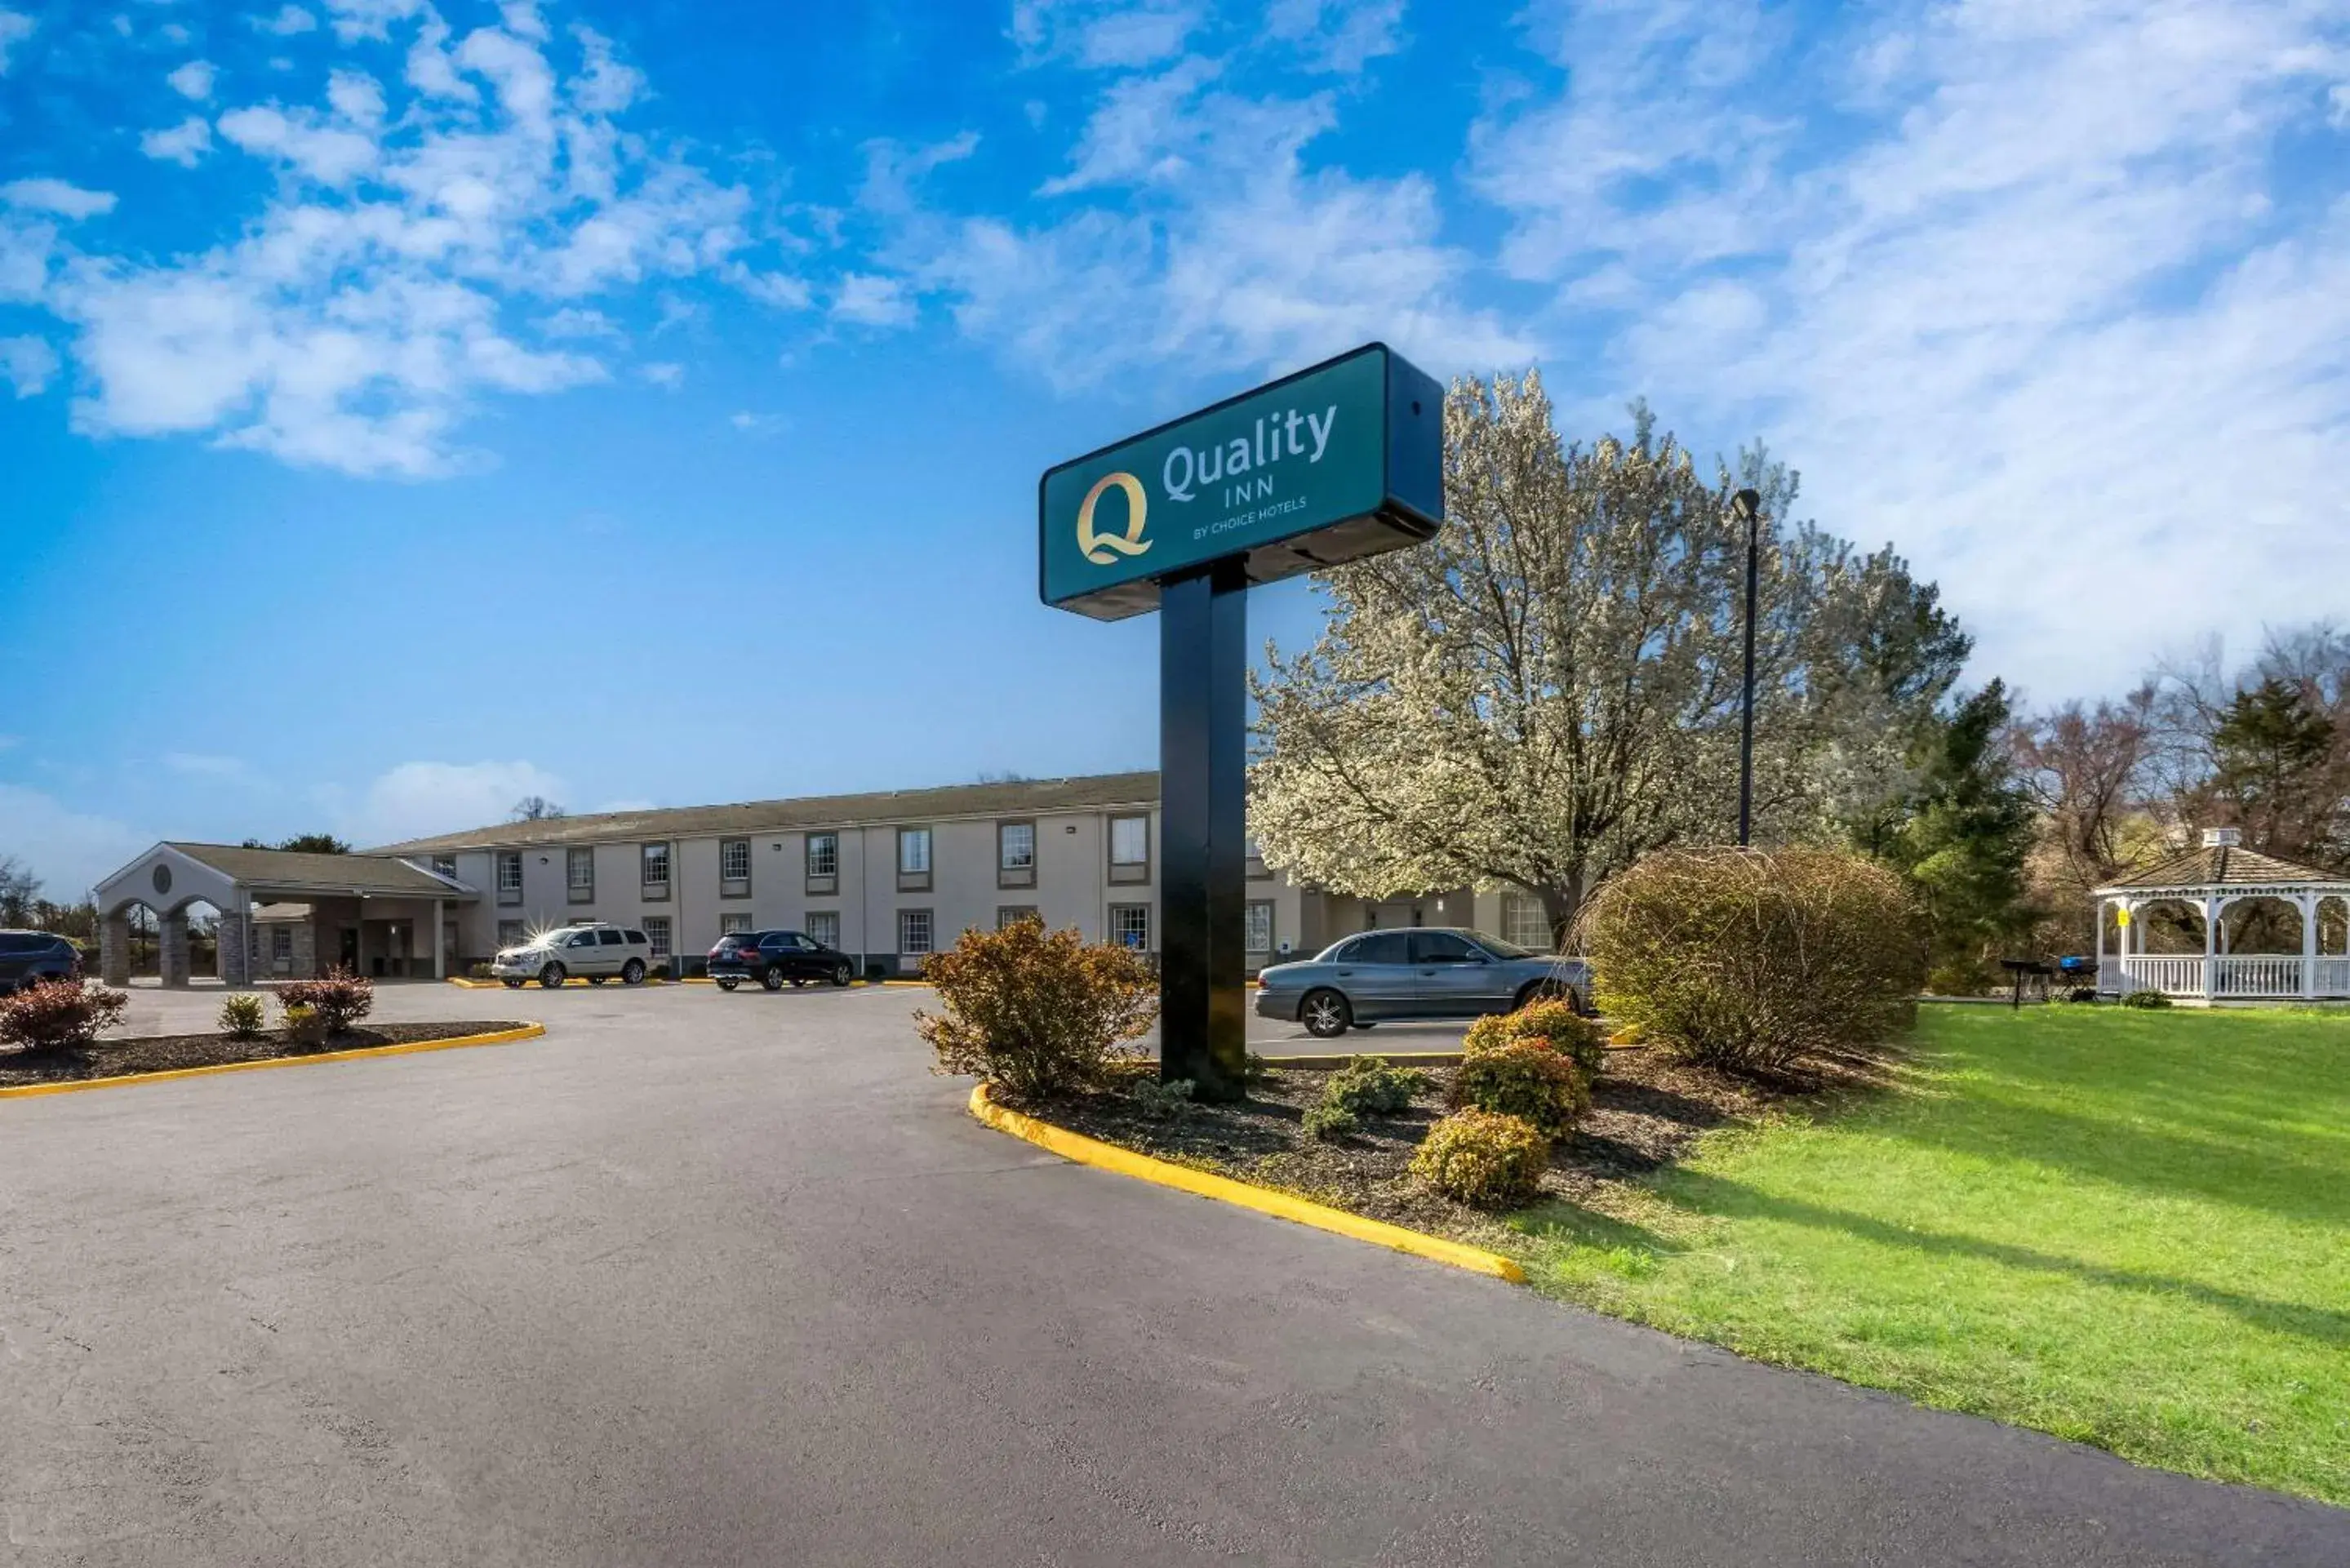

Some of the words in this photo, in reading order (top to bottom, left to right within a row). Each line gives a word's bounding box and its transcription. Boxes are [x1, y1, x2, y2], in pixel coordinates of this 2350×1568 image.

[1163, 405, 1337, 502] Quality
[1077, 472, 1153, 565] Q
[1193, 525, 1211, 540] BY
[1211, 512, 1256, 535] CHOICE
[1259, 496, 1307, 521] HOTELS
[1225, 475, 1273, 509] INN
